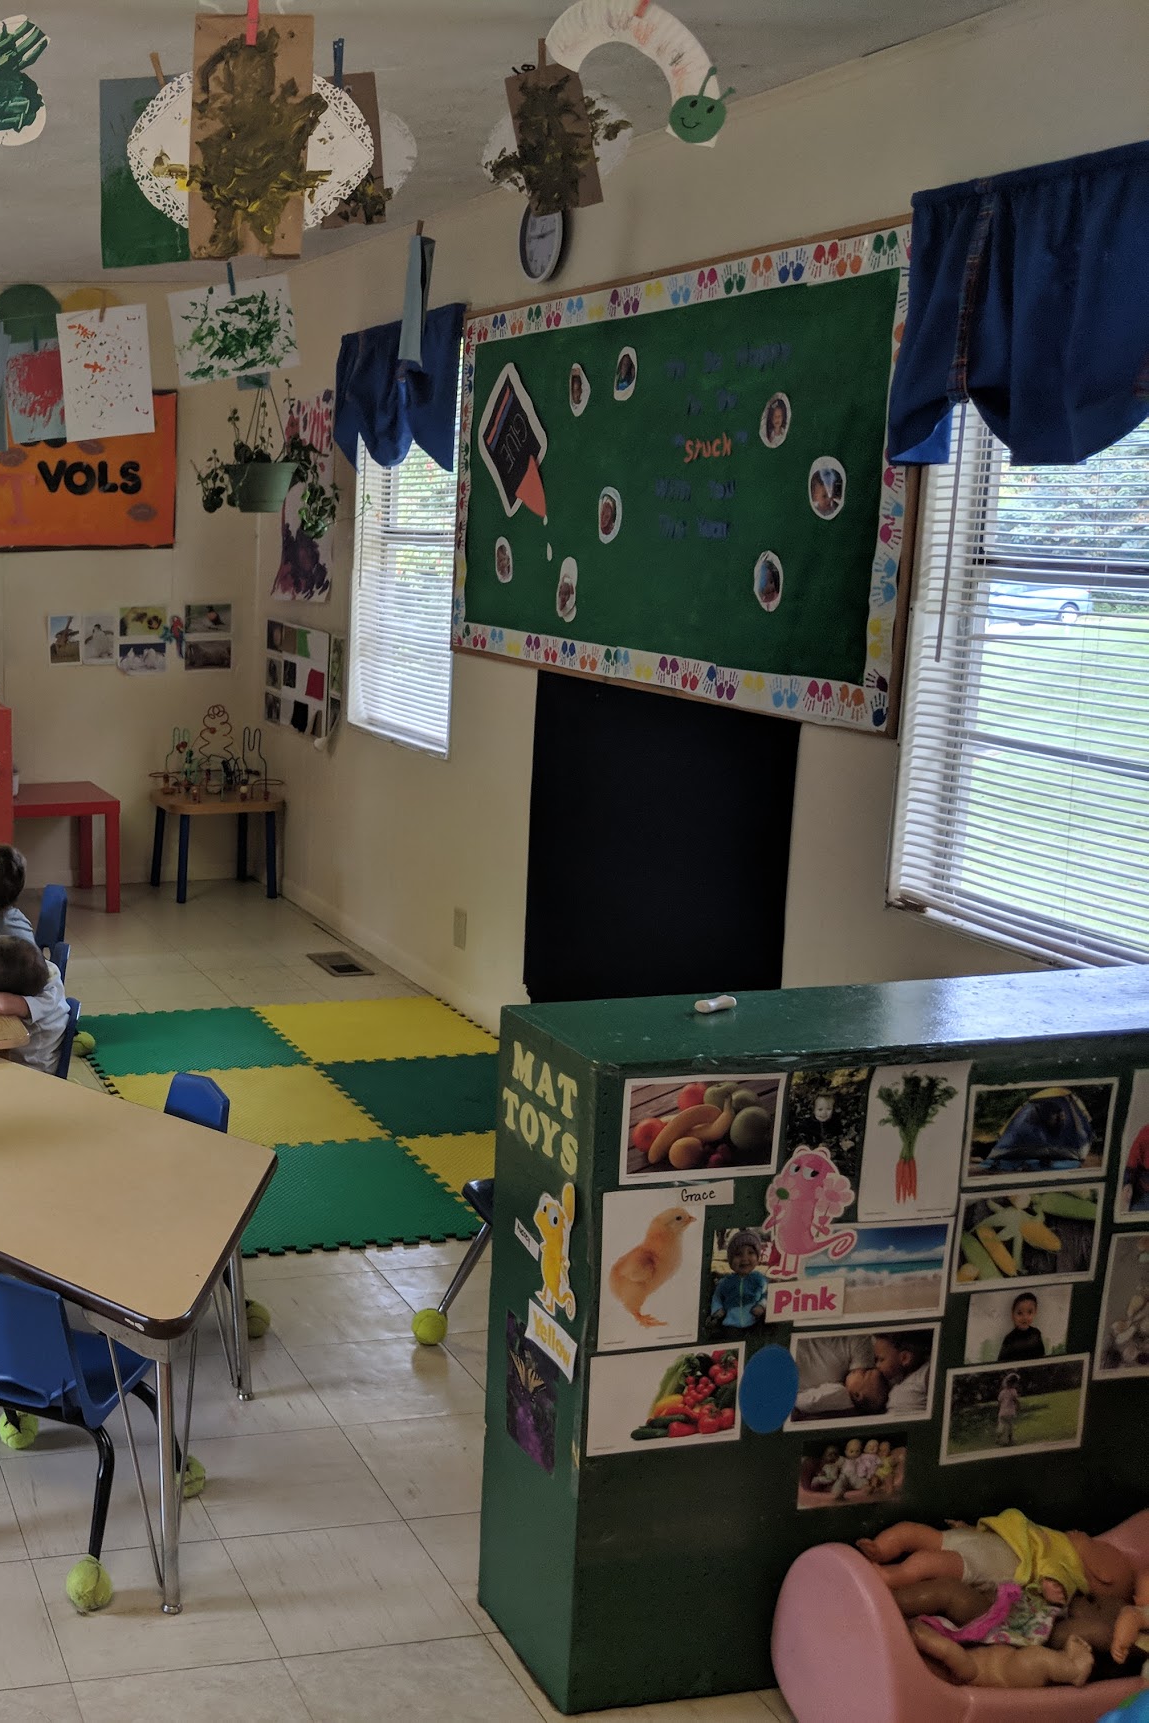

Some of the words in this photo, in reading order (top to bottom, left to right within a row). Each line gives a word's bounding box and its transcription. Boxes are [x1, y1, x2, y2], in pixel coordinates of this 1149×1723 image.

[37, 459, 142, 496] VOLS
[512, 1041, 578, 1120] MAT
[503, 1087, 579, 1176] TOYS
[680, 1188, 716, 1202] Grace
[773, 1286, 837, 1314] Pink
[533, 1310, 571, 1368] Yellow
